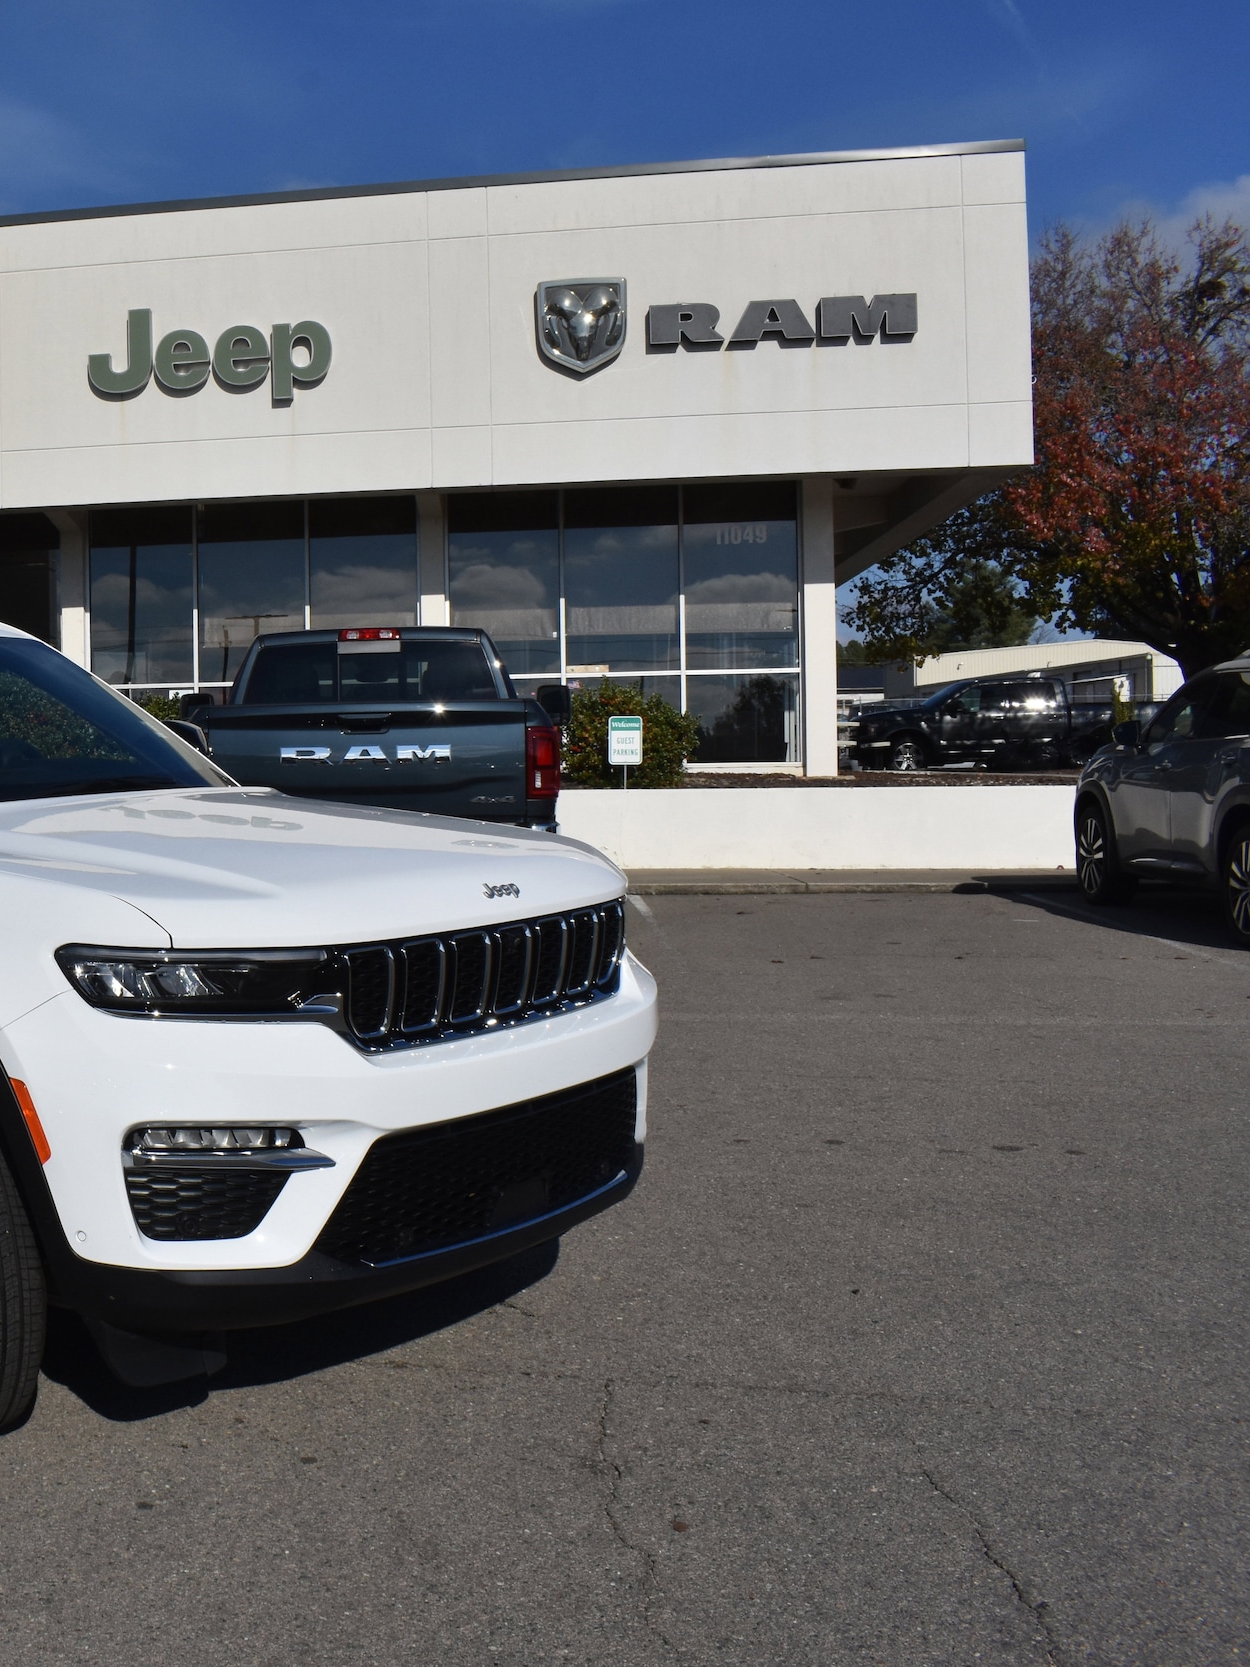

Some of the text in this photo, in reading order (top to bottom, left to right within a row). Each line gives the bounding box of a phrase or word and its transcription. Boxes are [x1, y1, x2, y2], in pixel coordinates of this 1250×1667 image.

[646, 293, 918, 354] RAM
[88, 308, 332, 408] Jeep
[716, 524, 767, 545] 11049
[280, 744, 452, 766] RAM
[613, 748, 638, 756] PARKING
[482, 882, 521, 899] Jeep
